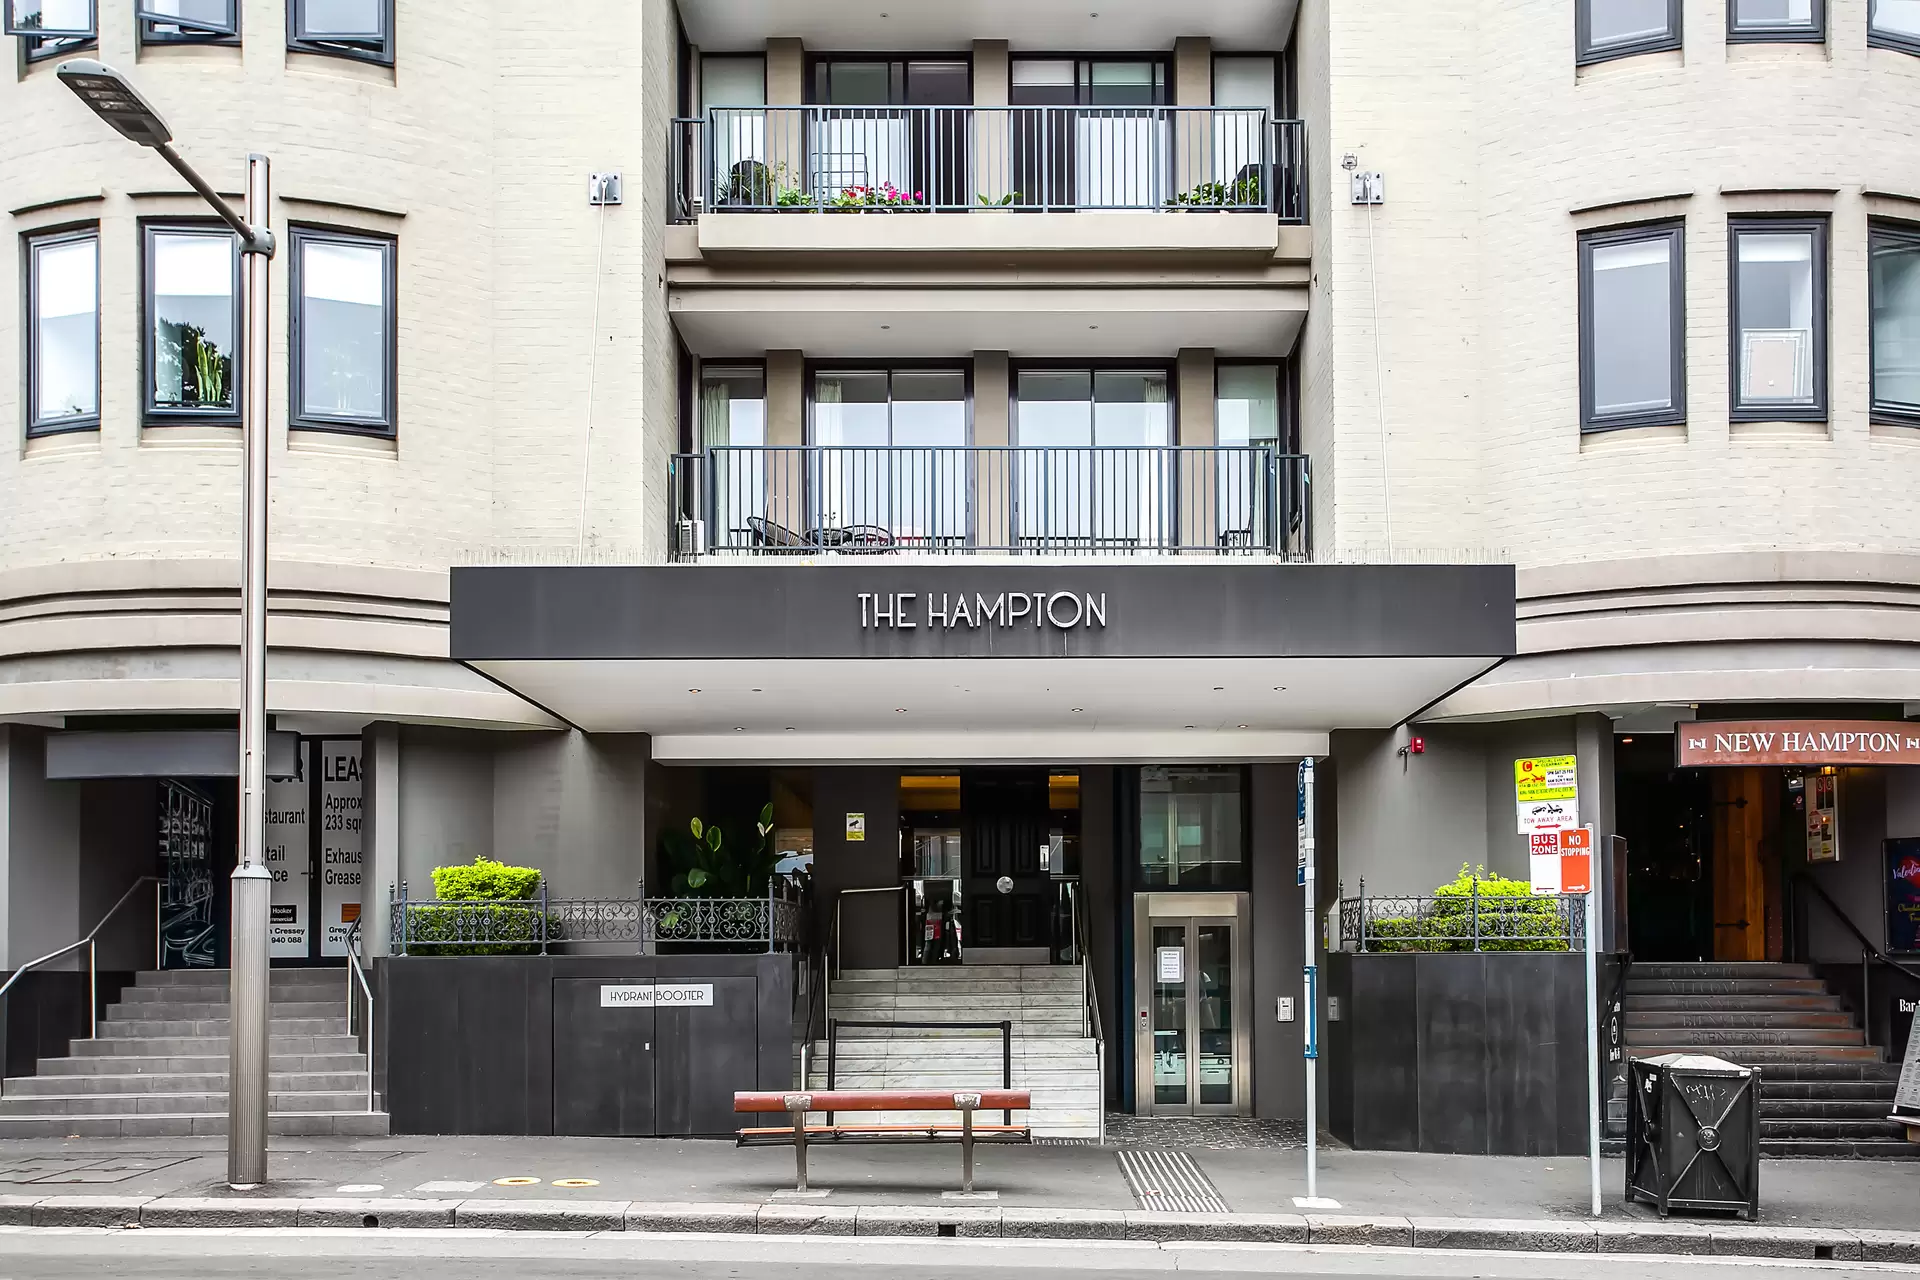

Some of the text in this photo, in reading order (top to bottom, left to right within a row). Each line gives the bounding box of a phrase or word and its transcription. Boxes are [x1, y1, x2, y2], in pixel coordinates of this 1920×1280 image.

[857, 591, 1106, 628] THE HAMPTON
[1713, 732, 1901, 753] NEW HAMPTON
[324, 755, 362, 782] LEA
[325, 793, 363, 813] Approx
[265, 808, 305, 824] staurant
[325, 814, 344, 831] 233
[1533, 835, 1556, 844] BUS
[1568, 835, 1581, 845] NO
[266, 845, 285, 861] tail
[325, 847, 363, 864] Exhaus
[1532, 845, 1558, 854] ZONE
[1561, 847, 1590, 856] STOPPING
[325, 869, 361, 885] Grease
[275, 927, 305, 935] Cressey
[328, 926, 347, 935] Greg
[610, 990, 704, 1001] HYDRANT BOOSTER
[1899, 998, 1916, 1012] Bar
